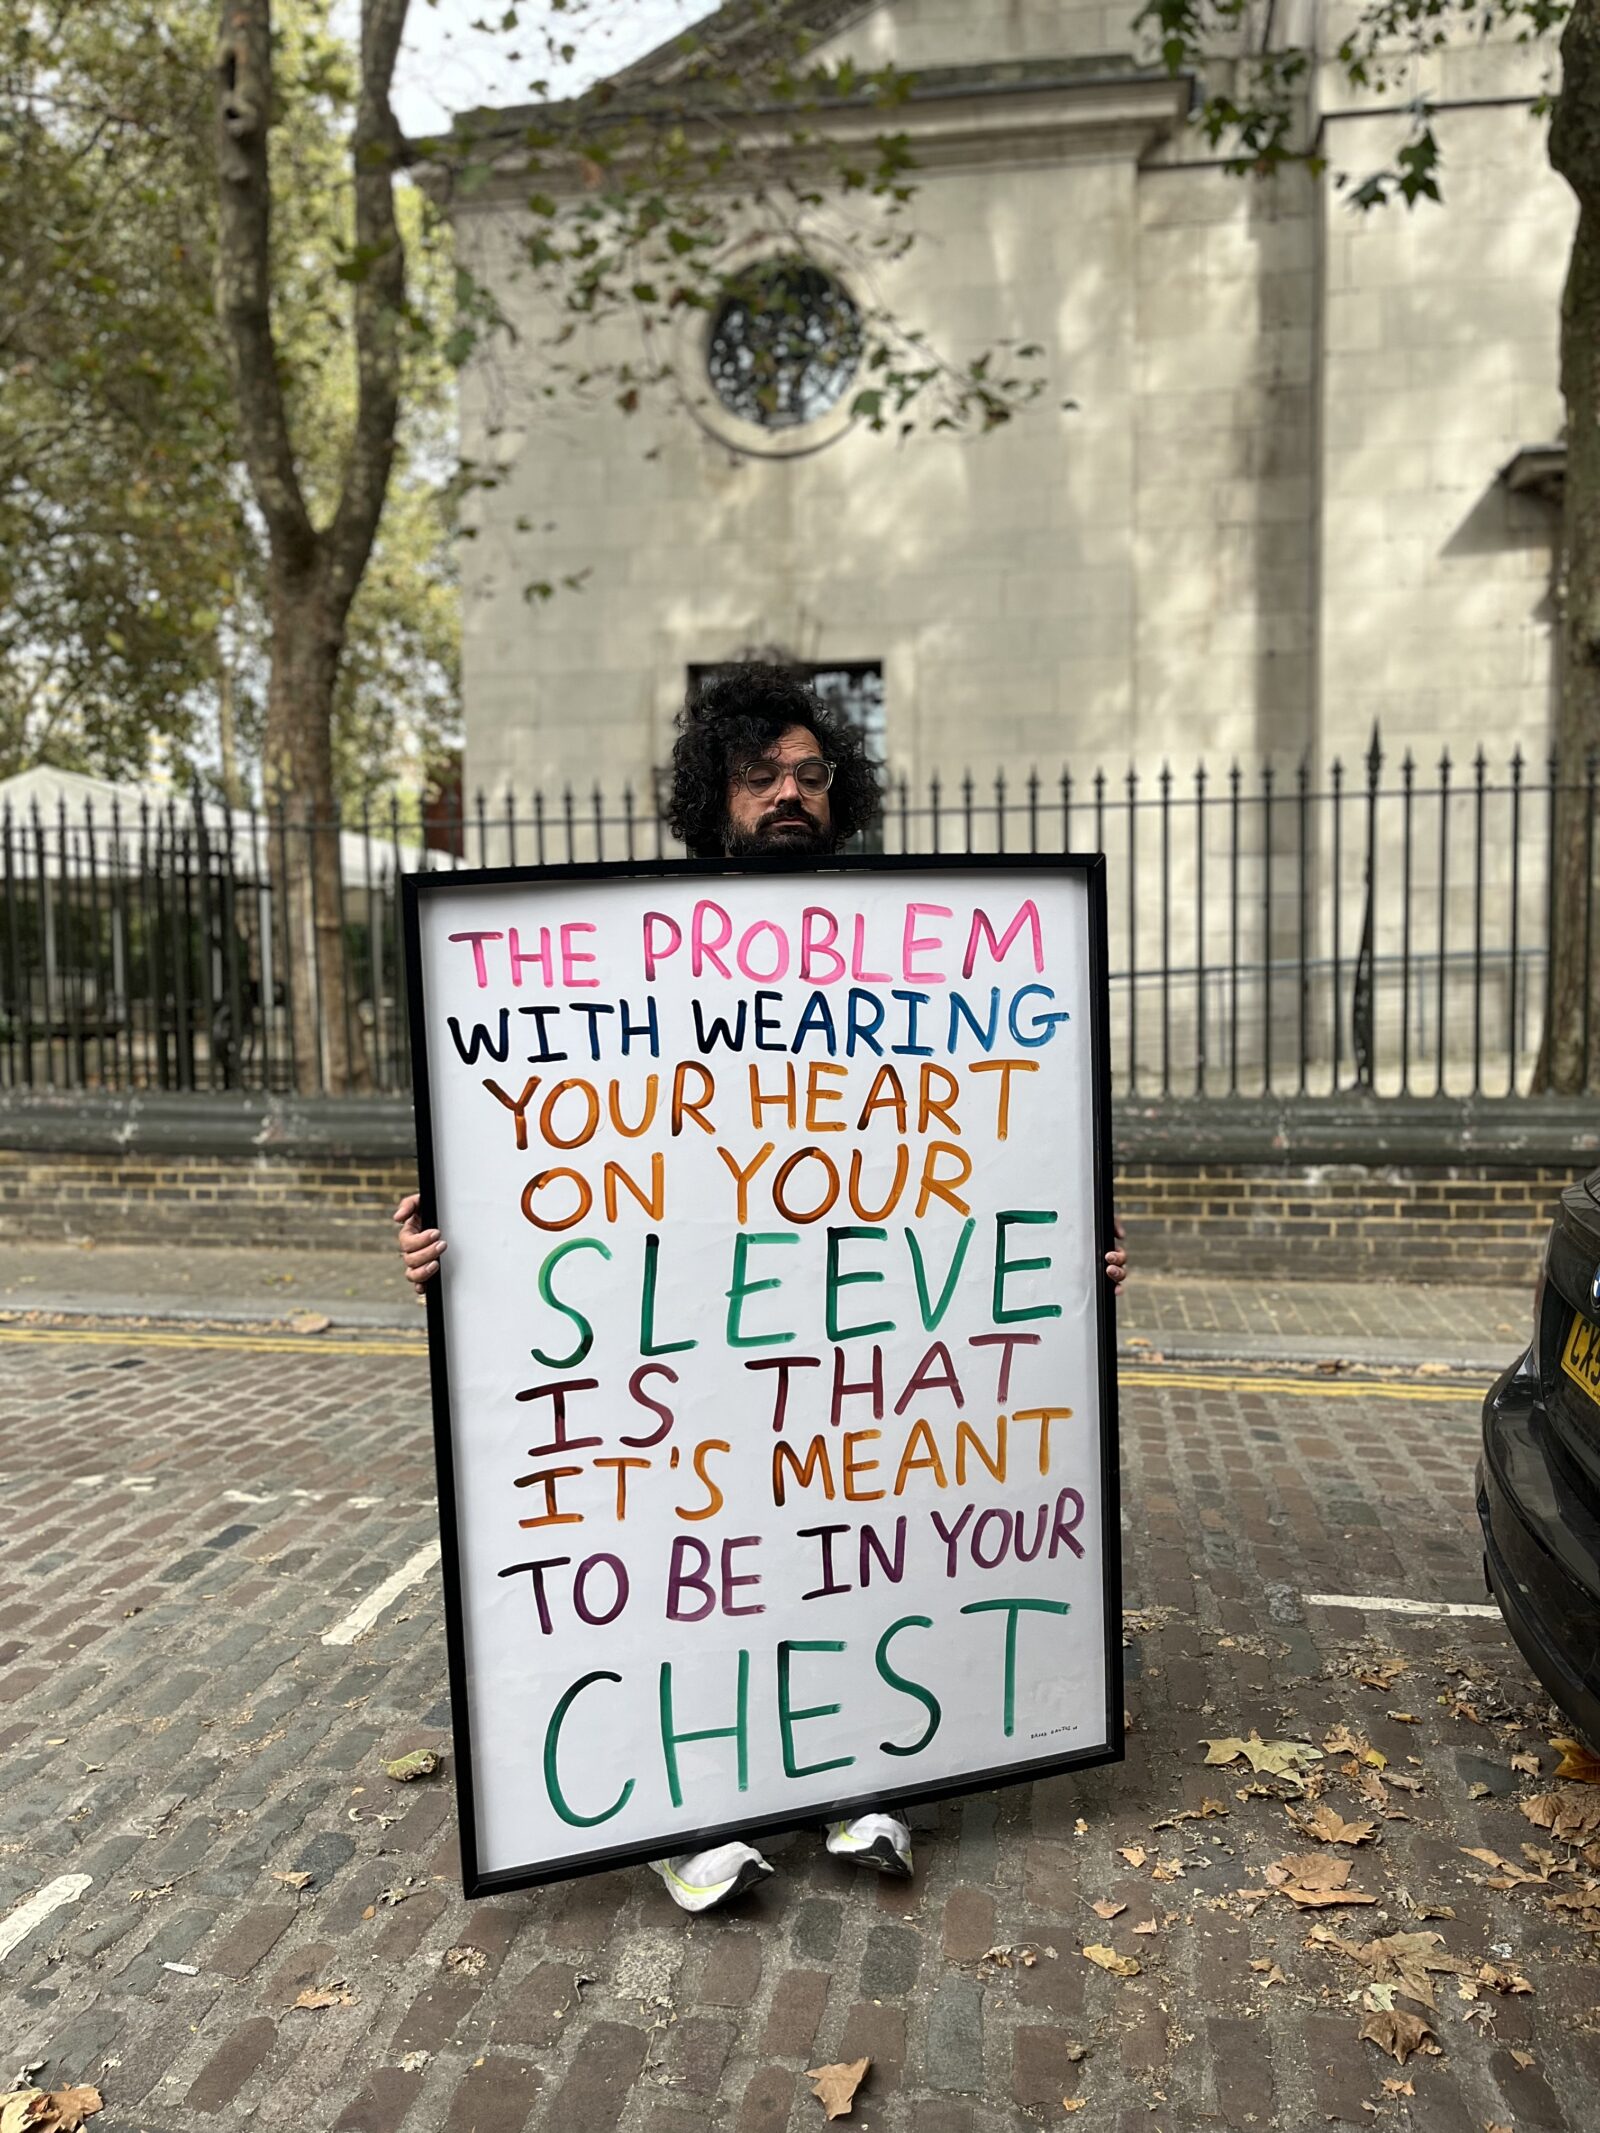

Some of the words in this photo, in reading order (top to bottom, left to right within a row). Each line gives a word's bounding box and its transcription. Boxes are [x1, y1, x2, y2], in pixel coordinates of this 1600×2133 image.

[449, 922, 600, 988] THE
[643, 899, 1044, 985] PROBLEM
[446, 995, 660, 1065] WITH
[691, 983, 1070, 1057] WEARING
[482, 1060, 716, 1150] YOUR
[749, 1059, 1040, 1140] HEART
[520, 1151, 664, 1232] ON
[717, 1141, 973, 1225] YOUR
[530, 1210, 1062, 1369] SLEEVE
[515, 1362, 679, 1457] IS
[744, 1333, 1042, 1432] THAT
[513, 1439, 731, 1528] IT'S
[772, 1407, 1073, 1507] MEANT
[498, 1552, 630, 1635] TO
[666, 1535, 767, 1622] BE
[797, 1515, 907, 1600] IN
[929, 1487, 1085, 1579] YOUR
[543, 1598, 1071, 1828] CHEST
